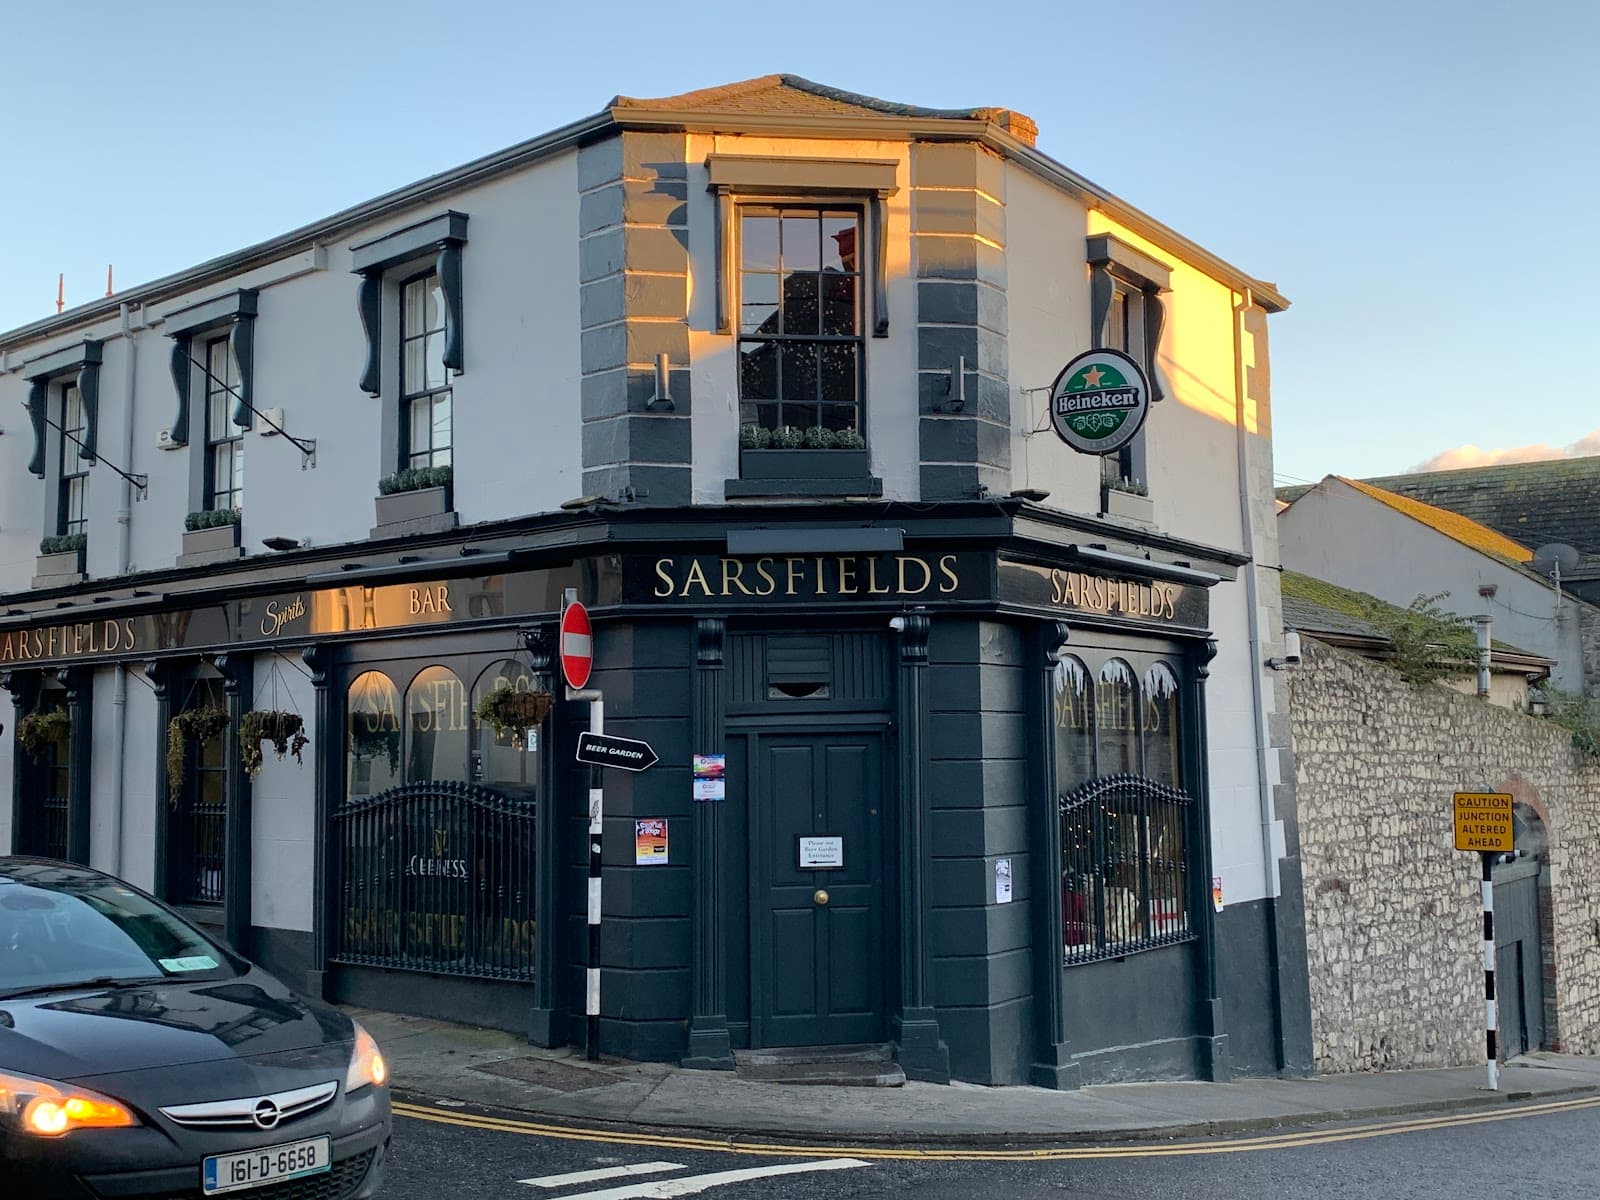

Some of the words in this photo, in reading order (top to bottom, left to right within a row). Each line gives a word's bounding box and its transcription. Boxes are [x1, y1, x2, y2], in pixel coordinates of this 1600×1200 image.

[1059, 391, 1136, 412] Heineken
[654, 555, 959, 597] SARSFIELDS
[409, 586, 453, 614] BAR
[1051, 568, 1175, 620] SARSFIELDS
[260, 595, 306, 636] Spirits
[586, 744, 608, 753] BEER
[609, 747, 643, 759] GARDEN
[1458, 797, 1509, 807] CAUTION
[1459, 812, 1509, 822] JUNCTION
[1463, 825, 1507, 834] ALTERED
[1468, 838, 1502, 847] AHEAD
[231, 1145, 316, 1183] 161-D-6658
